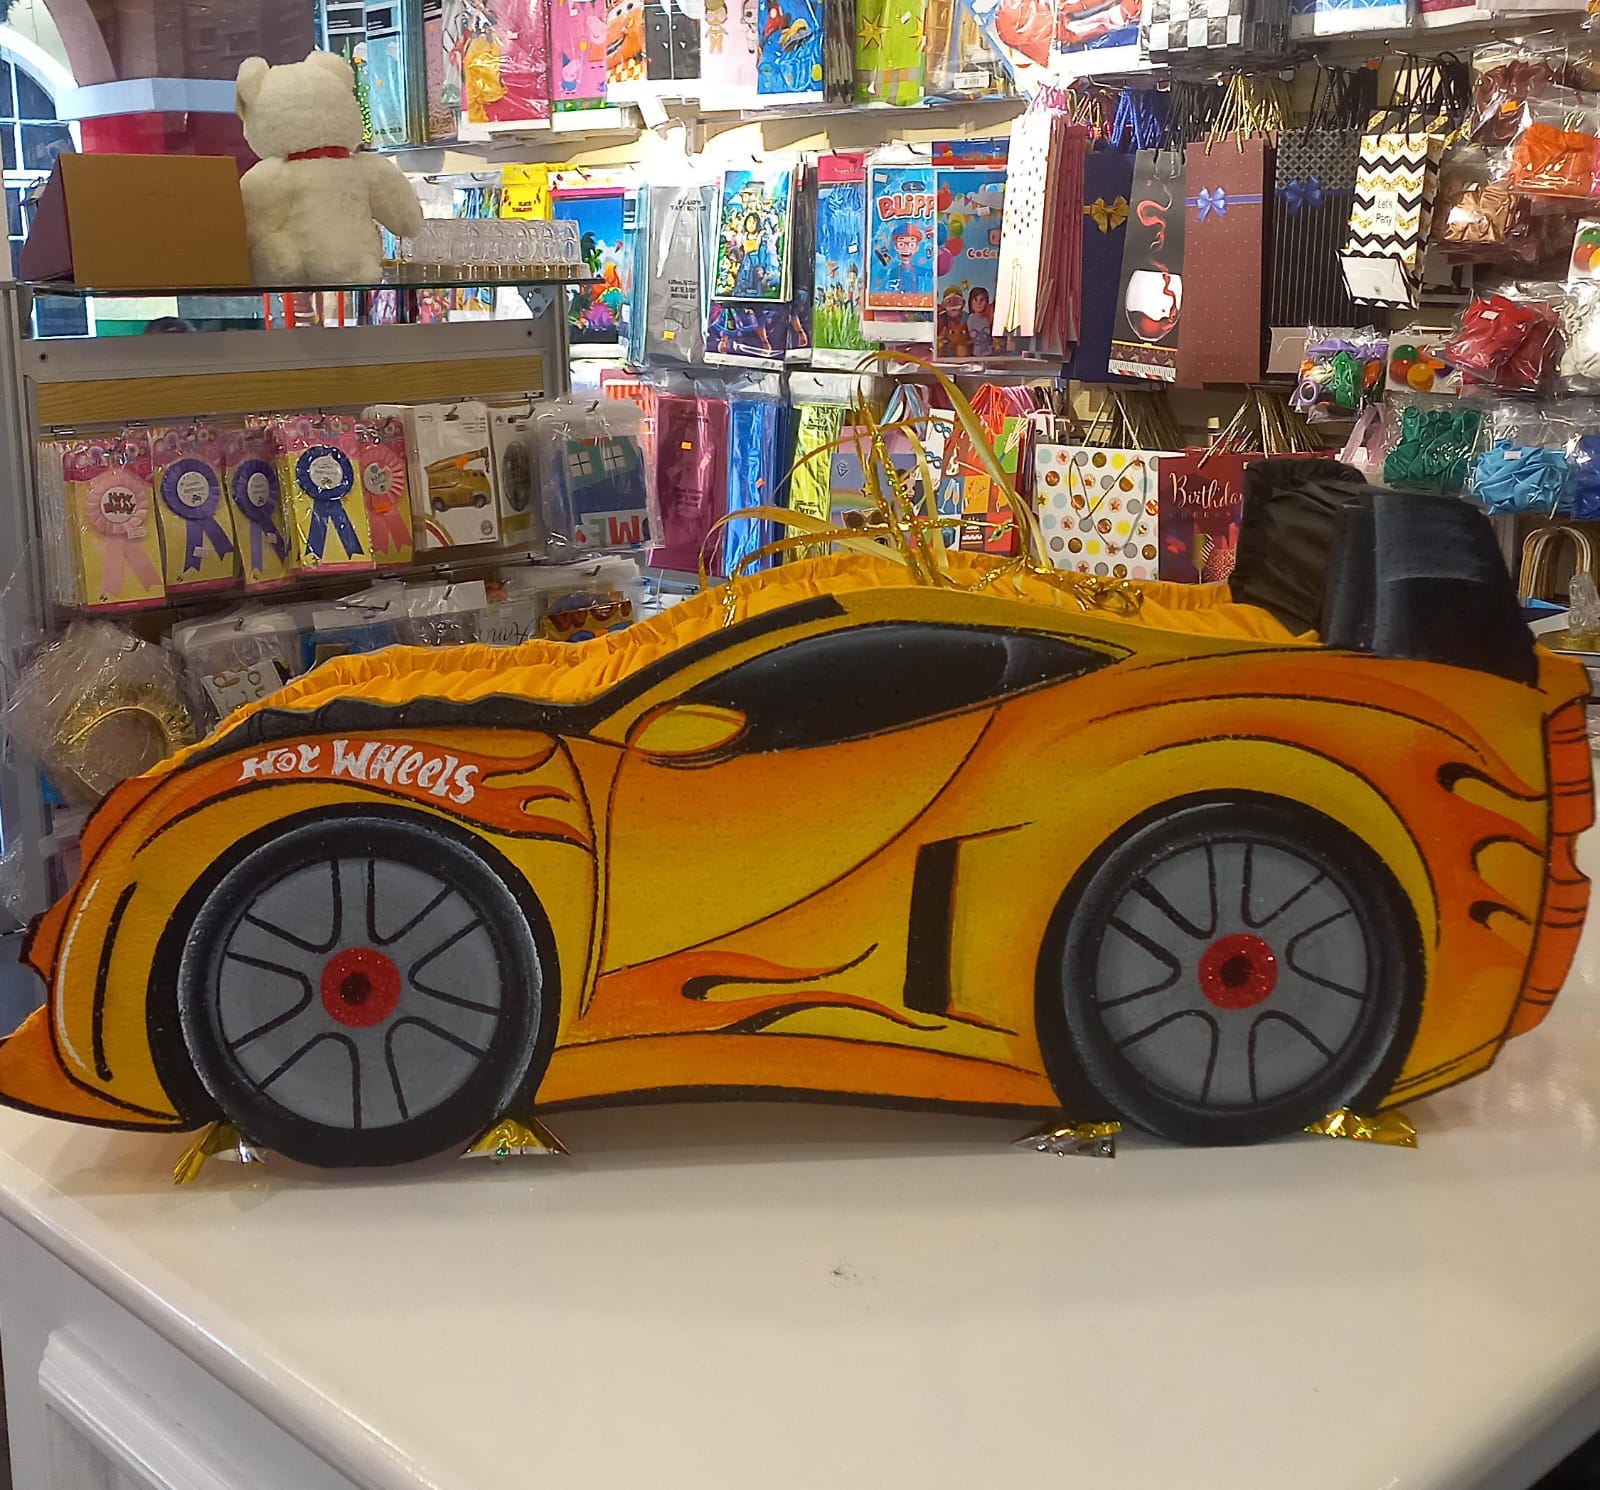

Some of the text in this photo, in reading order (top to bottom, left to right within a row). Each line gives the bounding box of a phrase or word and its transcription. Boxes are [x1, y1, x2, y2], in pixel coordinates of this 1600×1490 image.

[879, 195, 934, 220] BLiPP
[1376, 212, 1392, 226] Party
[968, 248, 1000, 258] CoCo
[1169, 472, 1243, 509] Birthda
